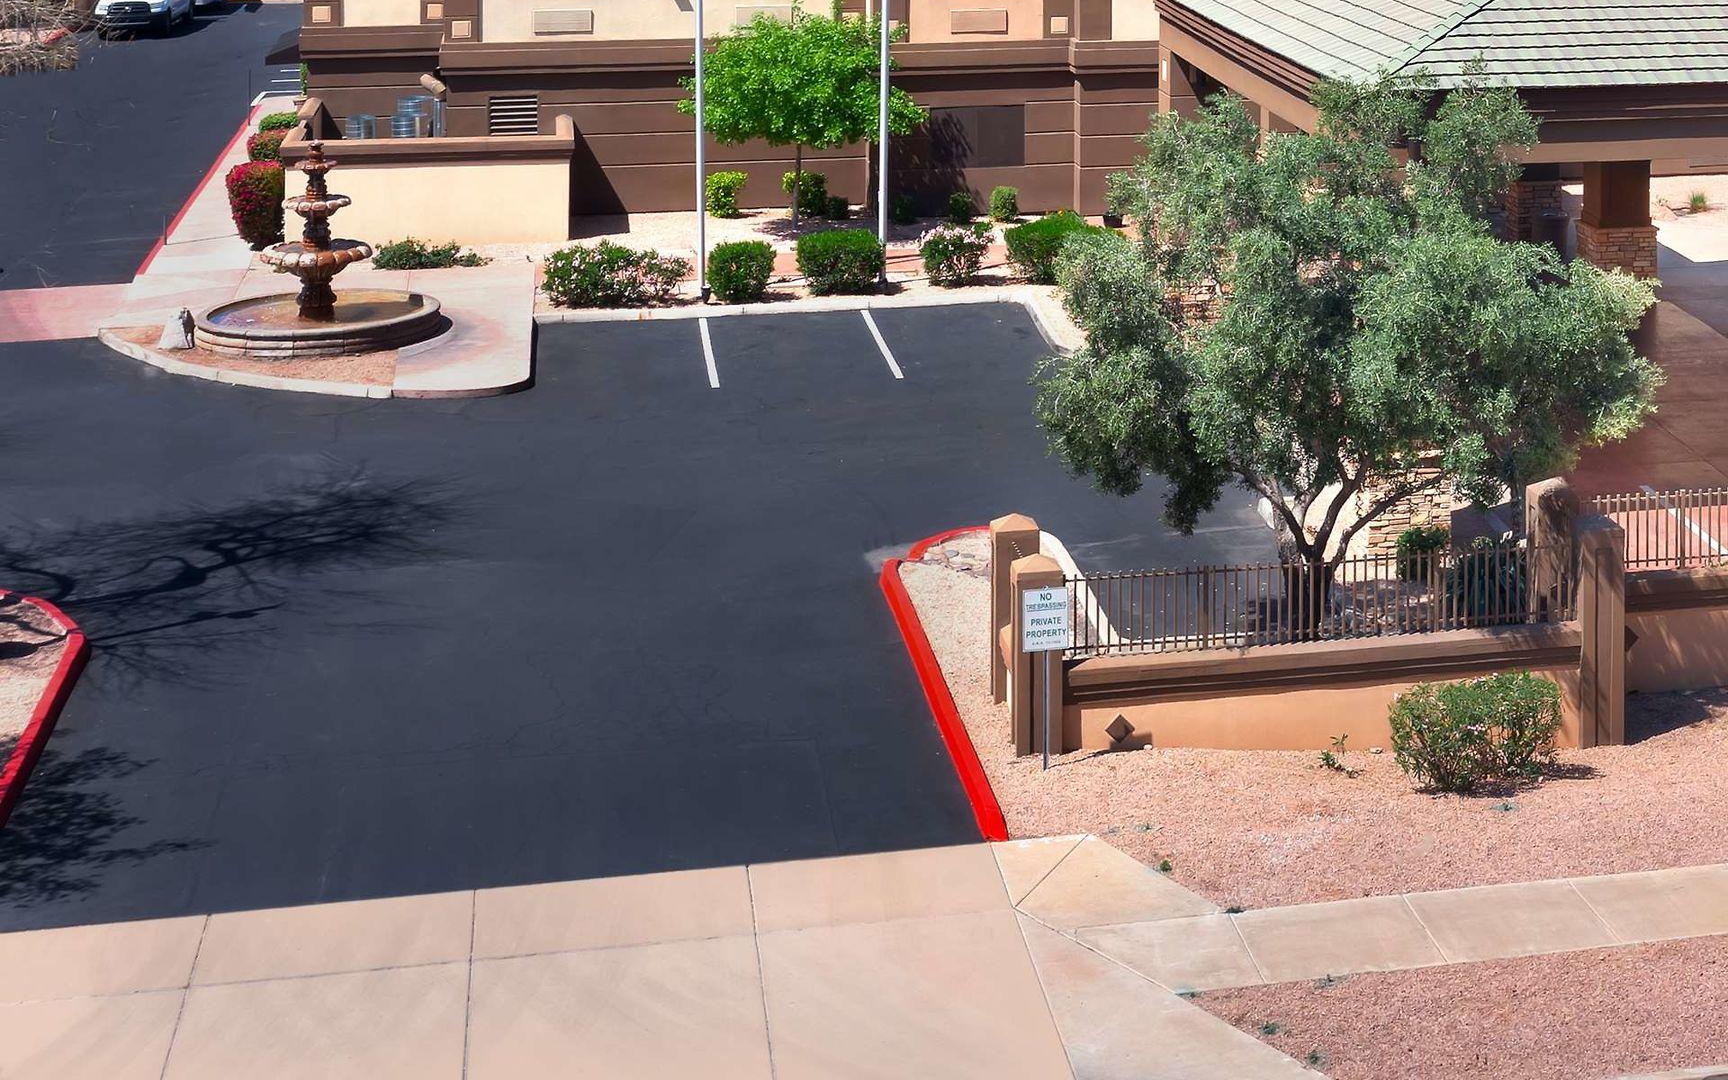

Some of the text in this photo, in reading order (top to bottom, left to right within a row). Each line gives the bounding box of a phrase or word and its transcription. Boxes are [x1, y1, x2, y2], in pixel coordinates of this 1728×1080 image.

[1040, 592, 1052, 601] NO
[1026, 601, 1067, 611] TRESPASSING
[1031, 617, 1062, 626] PRIVATE
[1026, 628, 1067, 638] PROPERTY
